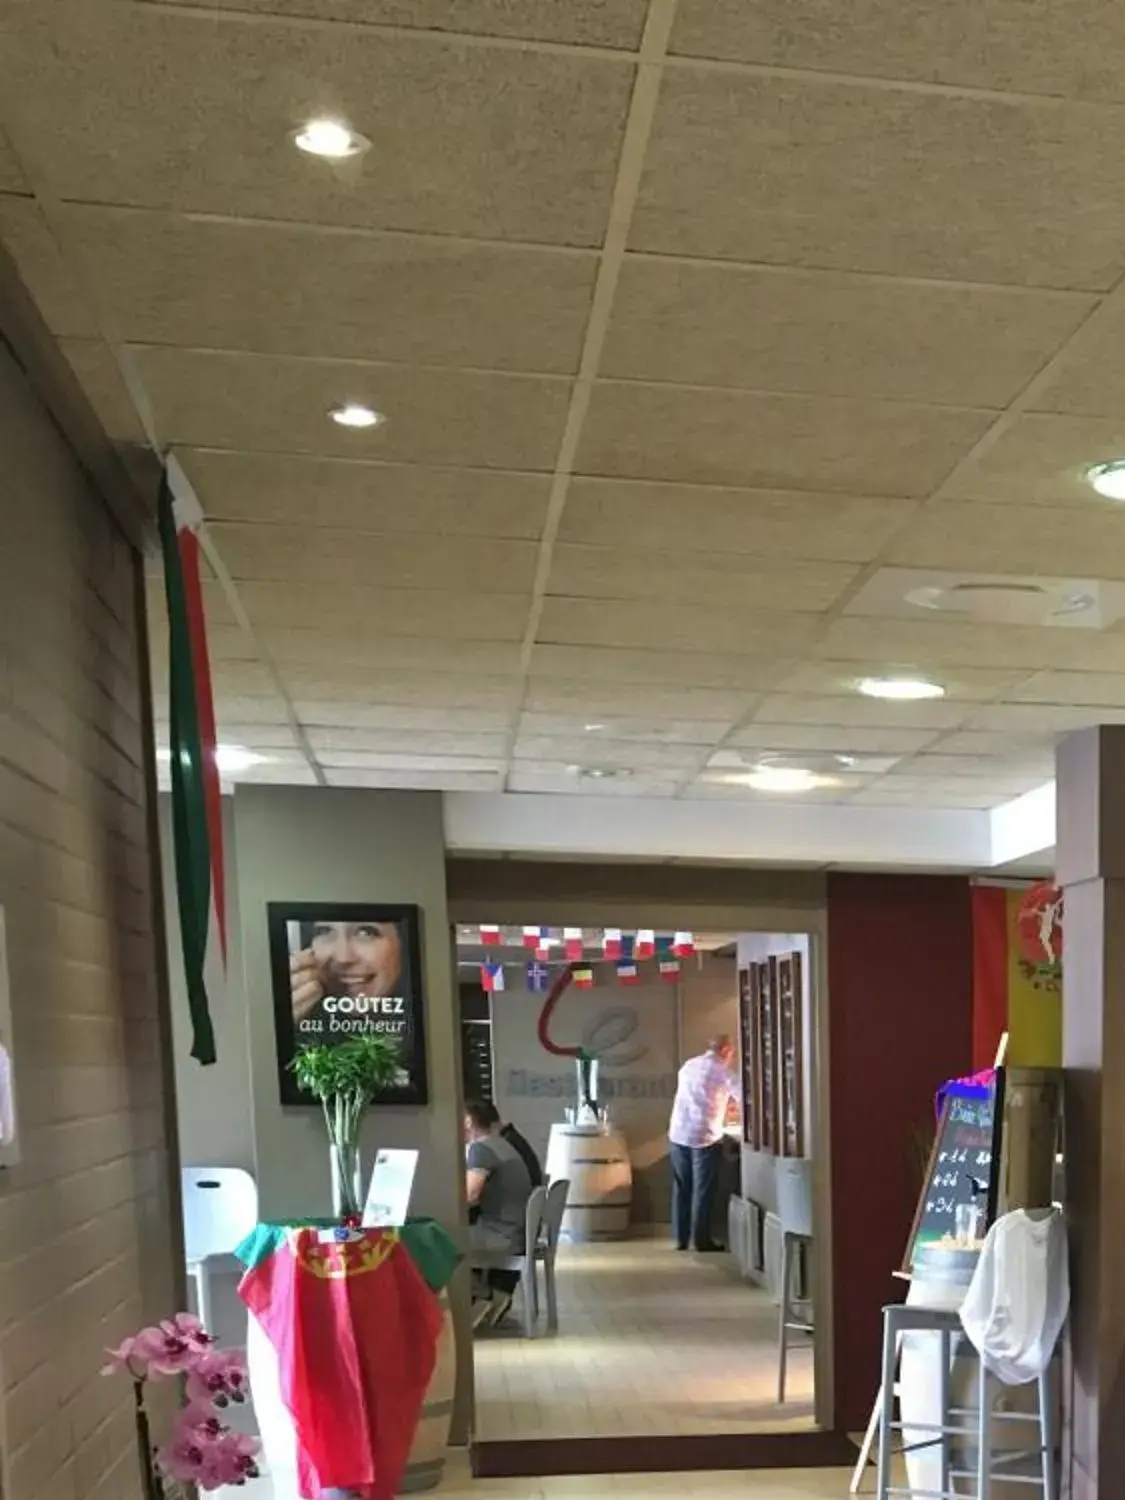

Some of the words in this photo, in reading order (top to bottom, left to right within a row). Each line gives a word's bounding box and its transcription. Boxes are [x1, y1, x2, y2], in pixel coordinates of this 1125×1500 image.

[322, 992, 405, 1014] GOÛTEZ
[299, 1018, 323, 1033] au
[328, 1014, 407, 1033] bonheur
